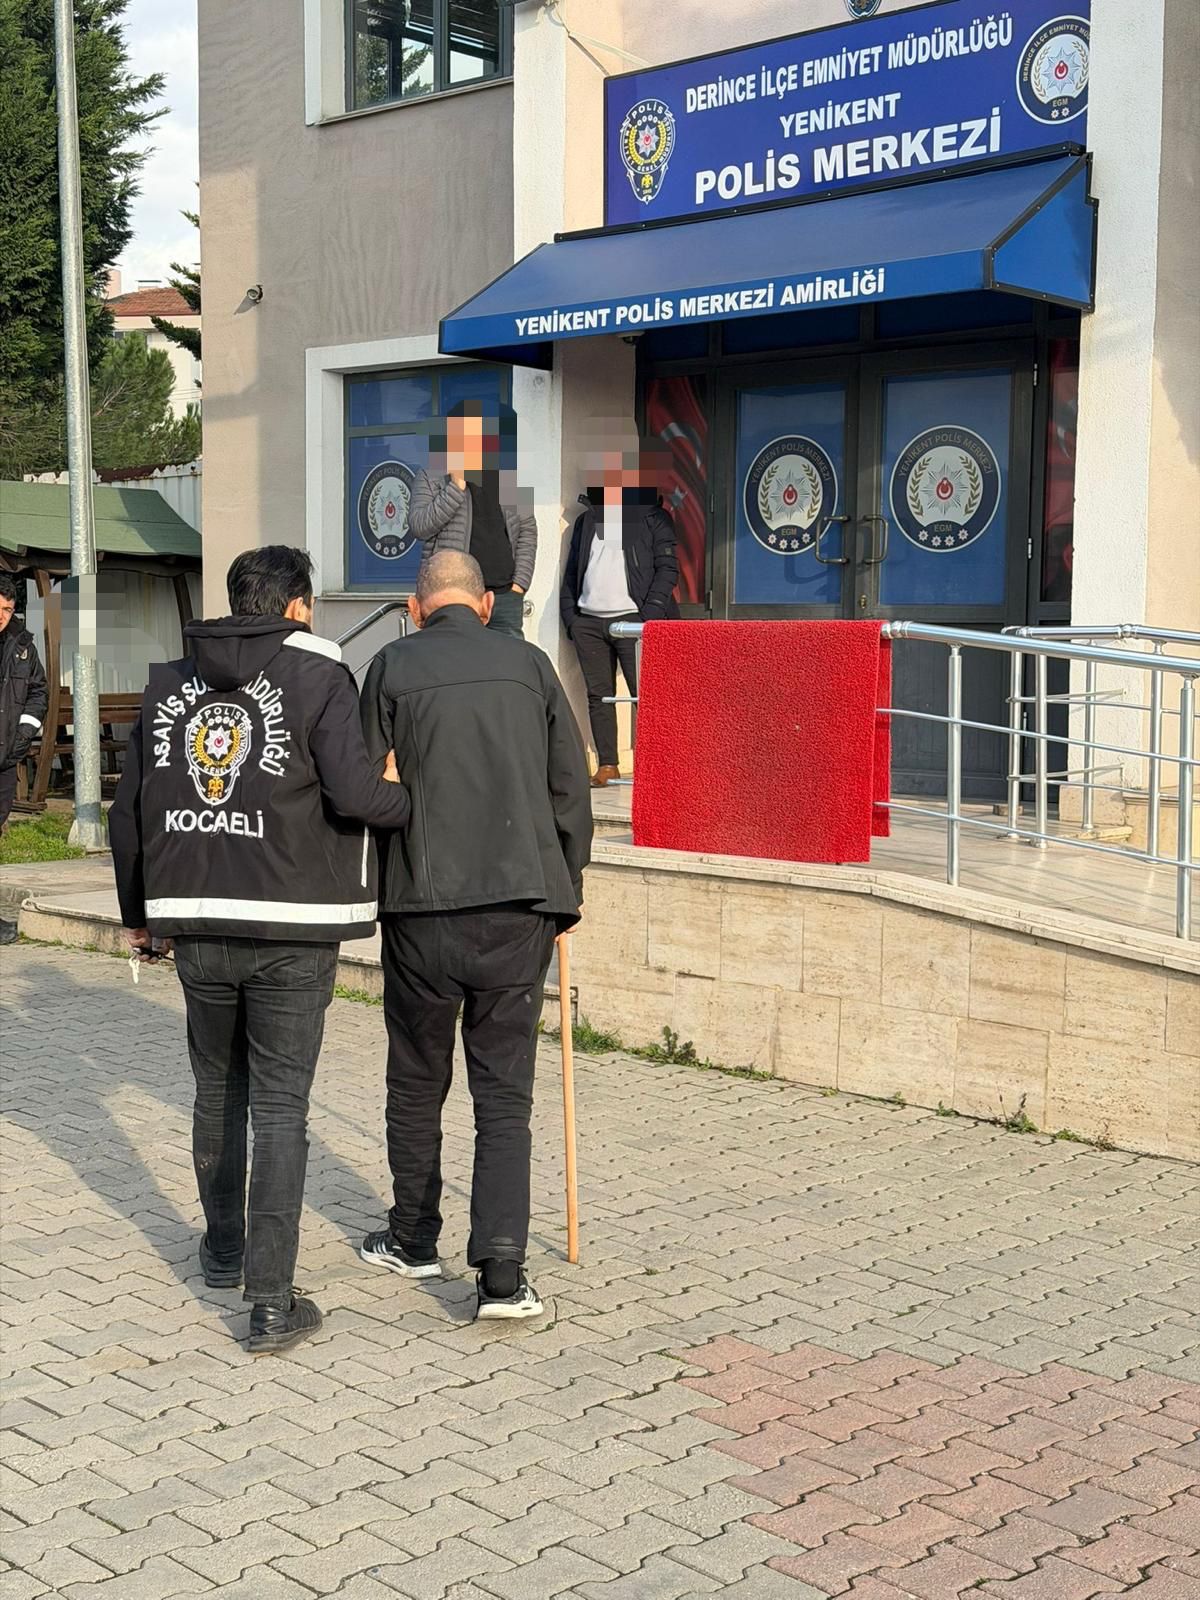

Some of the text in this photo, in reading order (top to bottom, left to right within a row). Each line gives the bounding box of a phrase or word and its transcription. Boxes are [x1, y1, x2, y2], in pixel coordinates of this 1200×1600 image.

[686, 15, 1013, 113] DERİNCE İLÇE EMNİYET MÜDÜRLÜĞÜ
[631, 101, 664, 120] POLİS
[779, 92, 901, 139] YENİKENT
[695, 107, 1002, 204] POLİS MERKEZİ
[515, 267, 885, 337] YENİKENT POLİS MERKEZİ AMİRLİĞİ
[152, 695, 186, 768] ASAYİŞ
[238, 670, 291, 777] ÜDÜRLÜĞÜ
[165, 808, 263, 839] KOCAELİ
